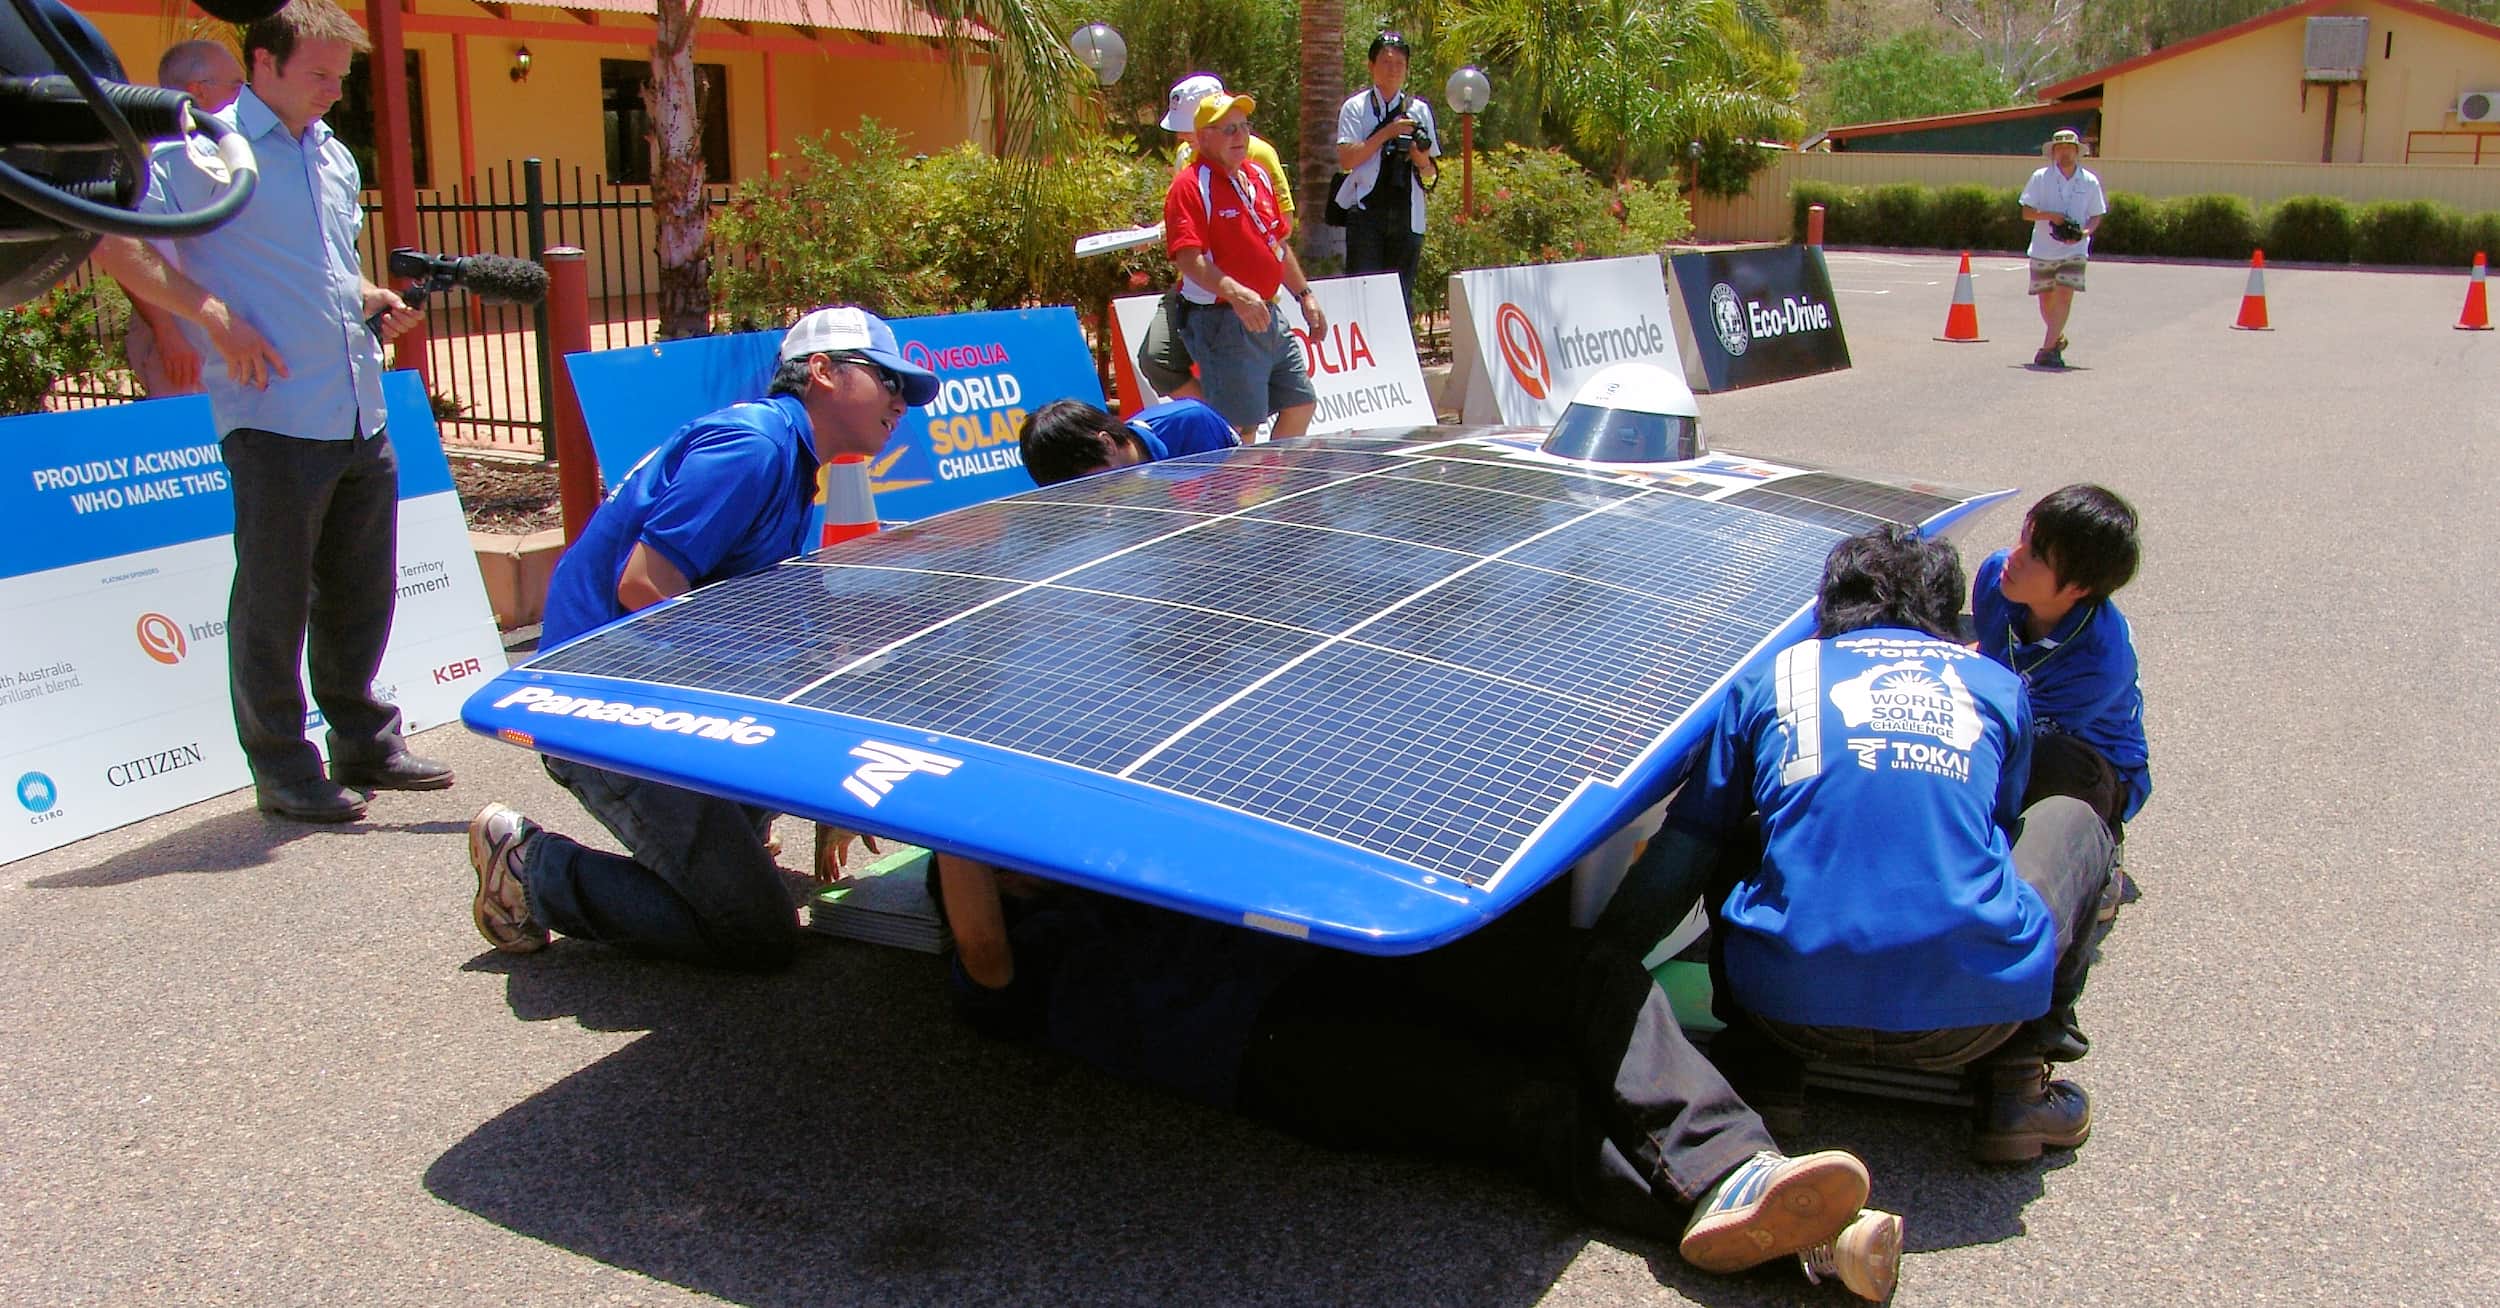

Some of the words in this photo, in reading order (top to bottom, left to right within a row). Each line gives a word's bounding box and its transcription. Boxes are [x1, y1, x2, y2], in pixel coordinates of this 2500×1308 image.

[1553, 314, 1664, 370] Internode
[933, 343, 1009, 370] VEOLIA
[32, 457, 129, 492] PROUDLY
[71, 489, 123, 514] WHO
[124, 479, 184, 506] MAKE
[181, 470, 227, 496] THIS
[400, 559, 444, 577] Territory
[394, 573, 450, 599] rnment
[433, 657, 481, 685] KBR
[493, 685, 776, 746] Panasonic
[1871, 693, 1954, 712] WORLD
[1871, 707, 1954, 729] SOLAR
[1872, 721, 1954, 740] CHALLENGE
[107, 743, 203, 787] CITIZEN
[1891, 742, 1970, 776] TOKAI
[1891, 760, 1969, 784] UNIVERSITY
[30, 809, 64, 825] CSIRO
